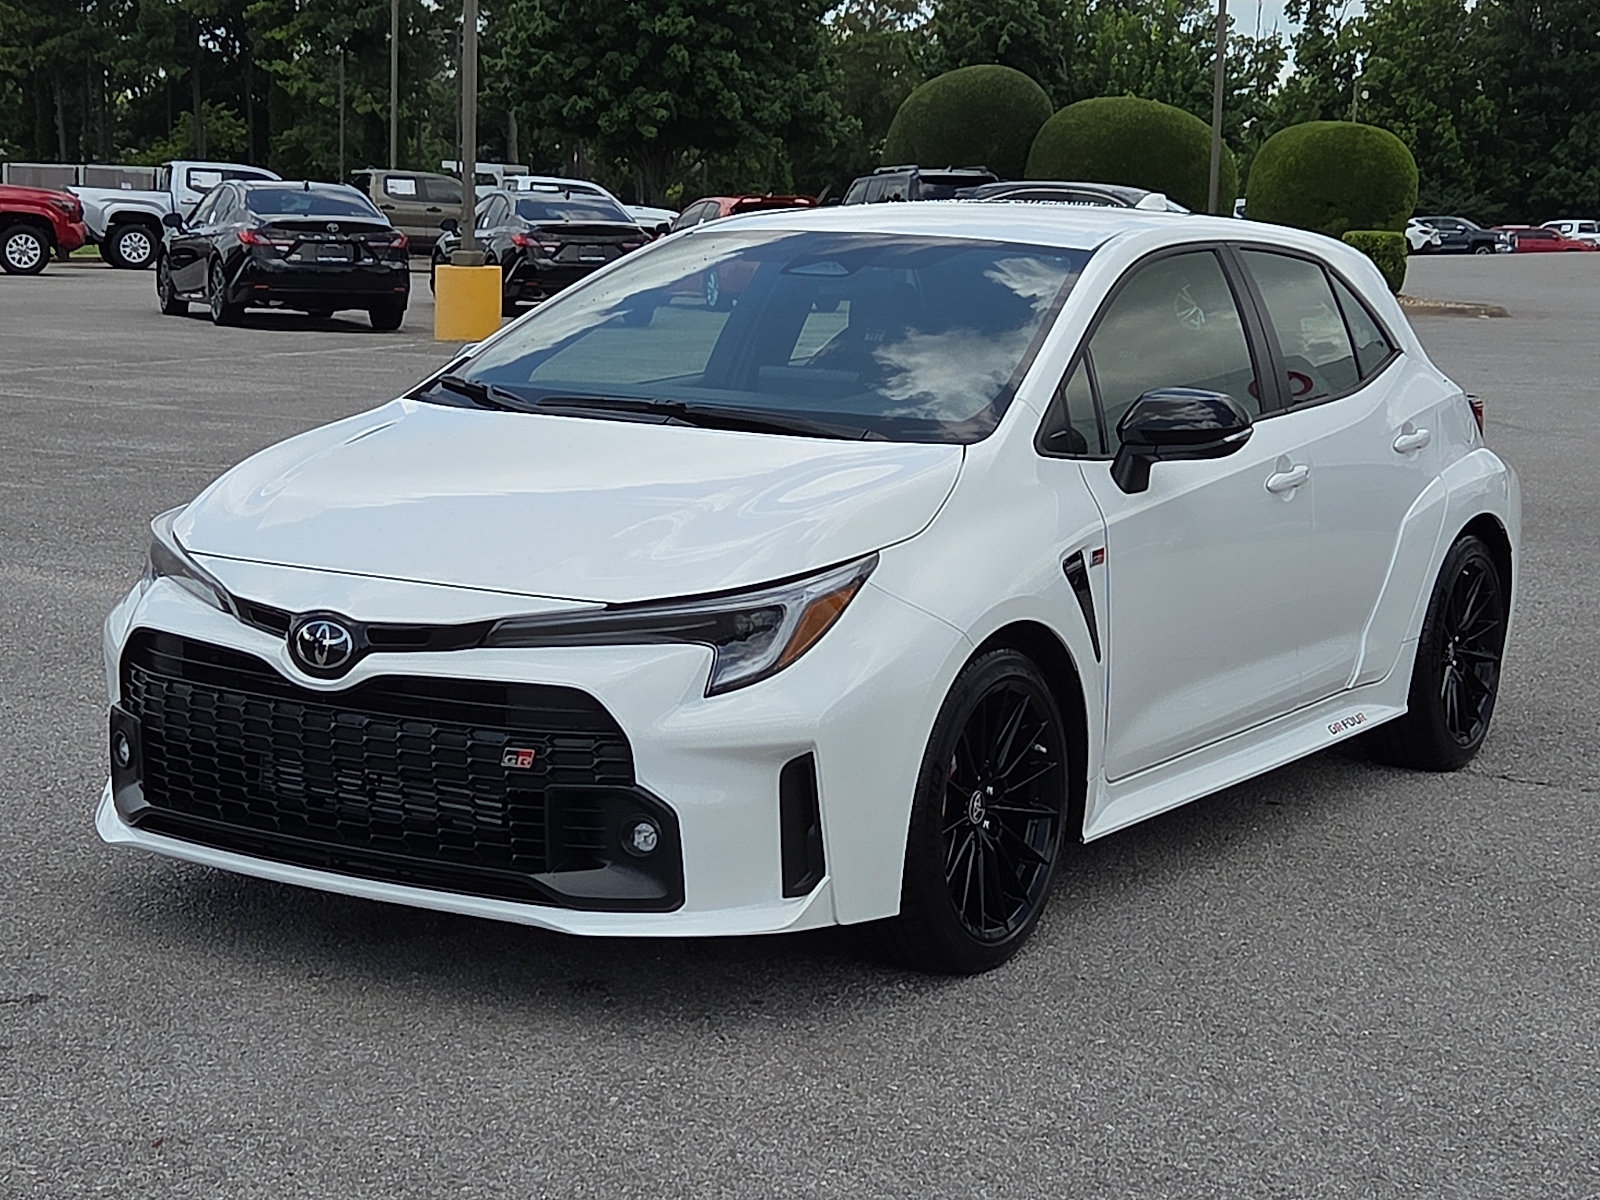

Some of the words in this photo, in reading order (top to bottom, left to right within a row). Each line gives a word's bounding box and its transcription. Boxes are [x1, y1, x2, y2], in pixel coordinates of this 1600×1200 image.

[1328, 722, 1344, 735] GR
[1341, 712, 1367, 729] FOUR
[503, 753, 533, 768] GR
